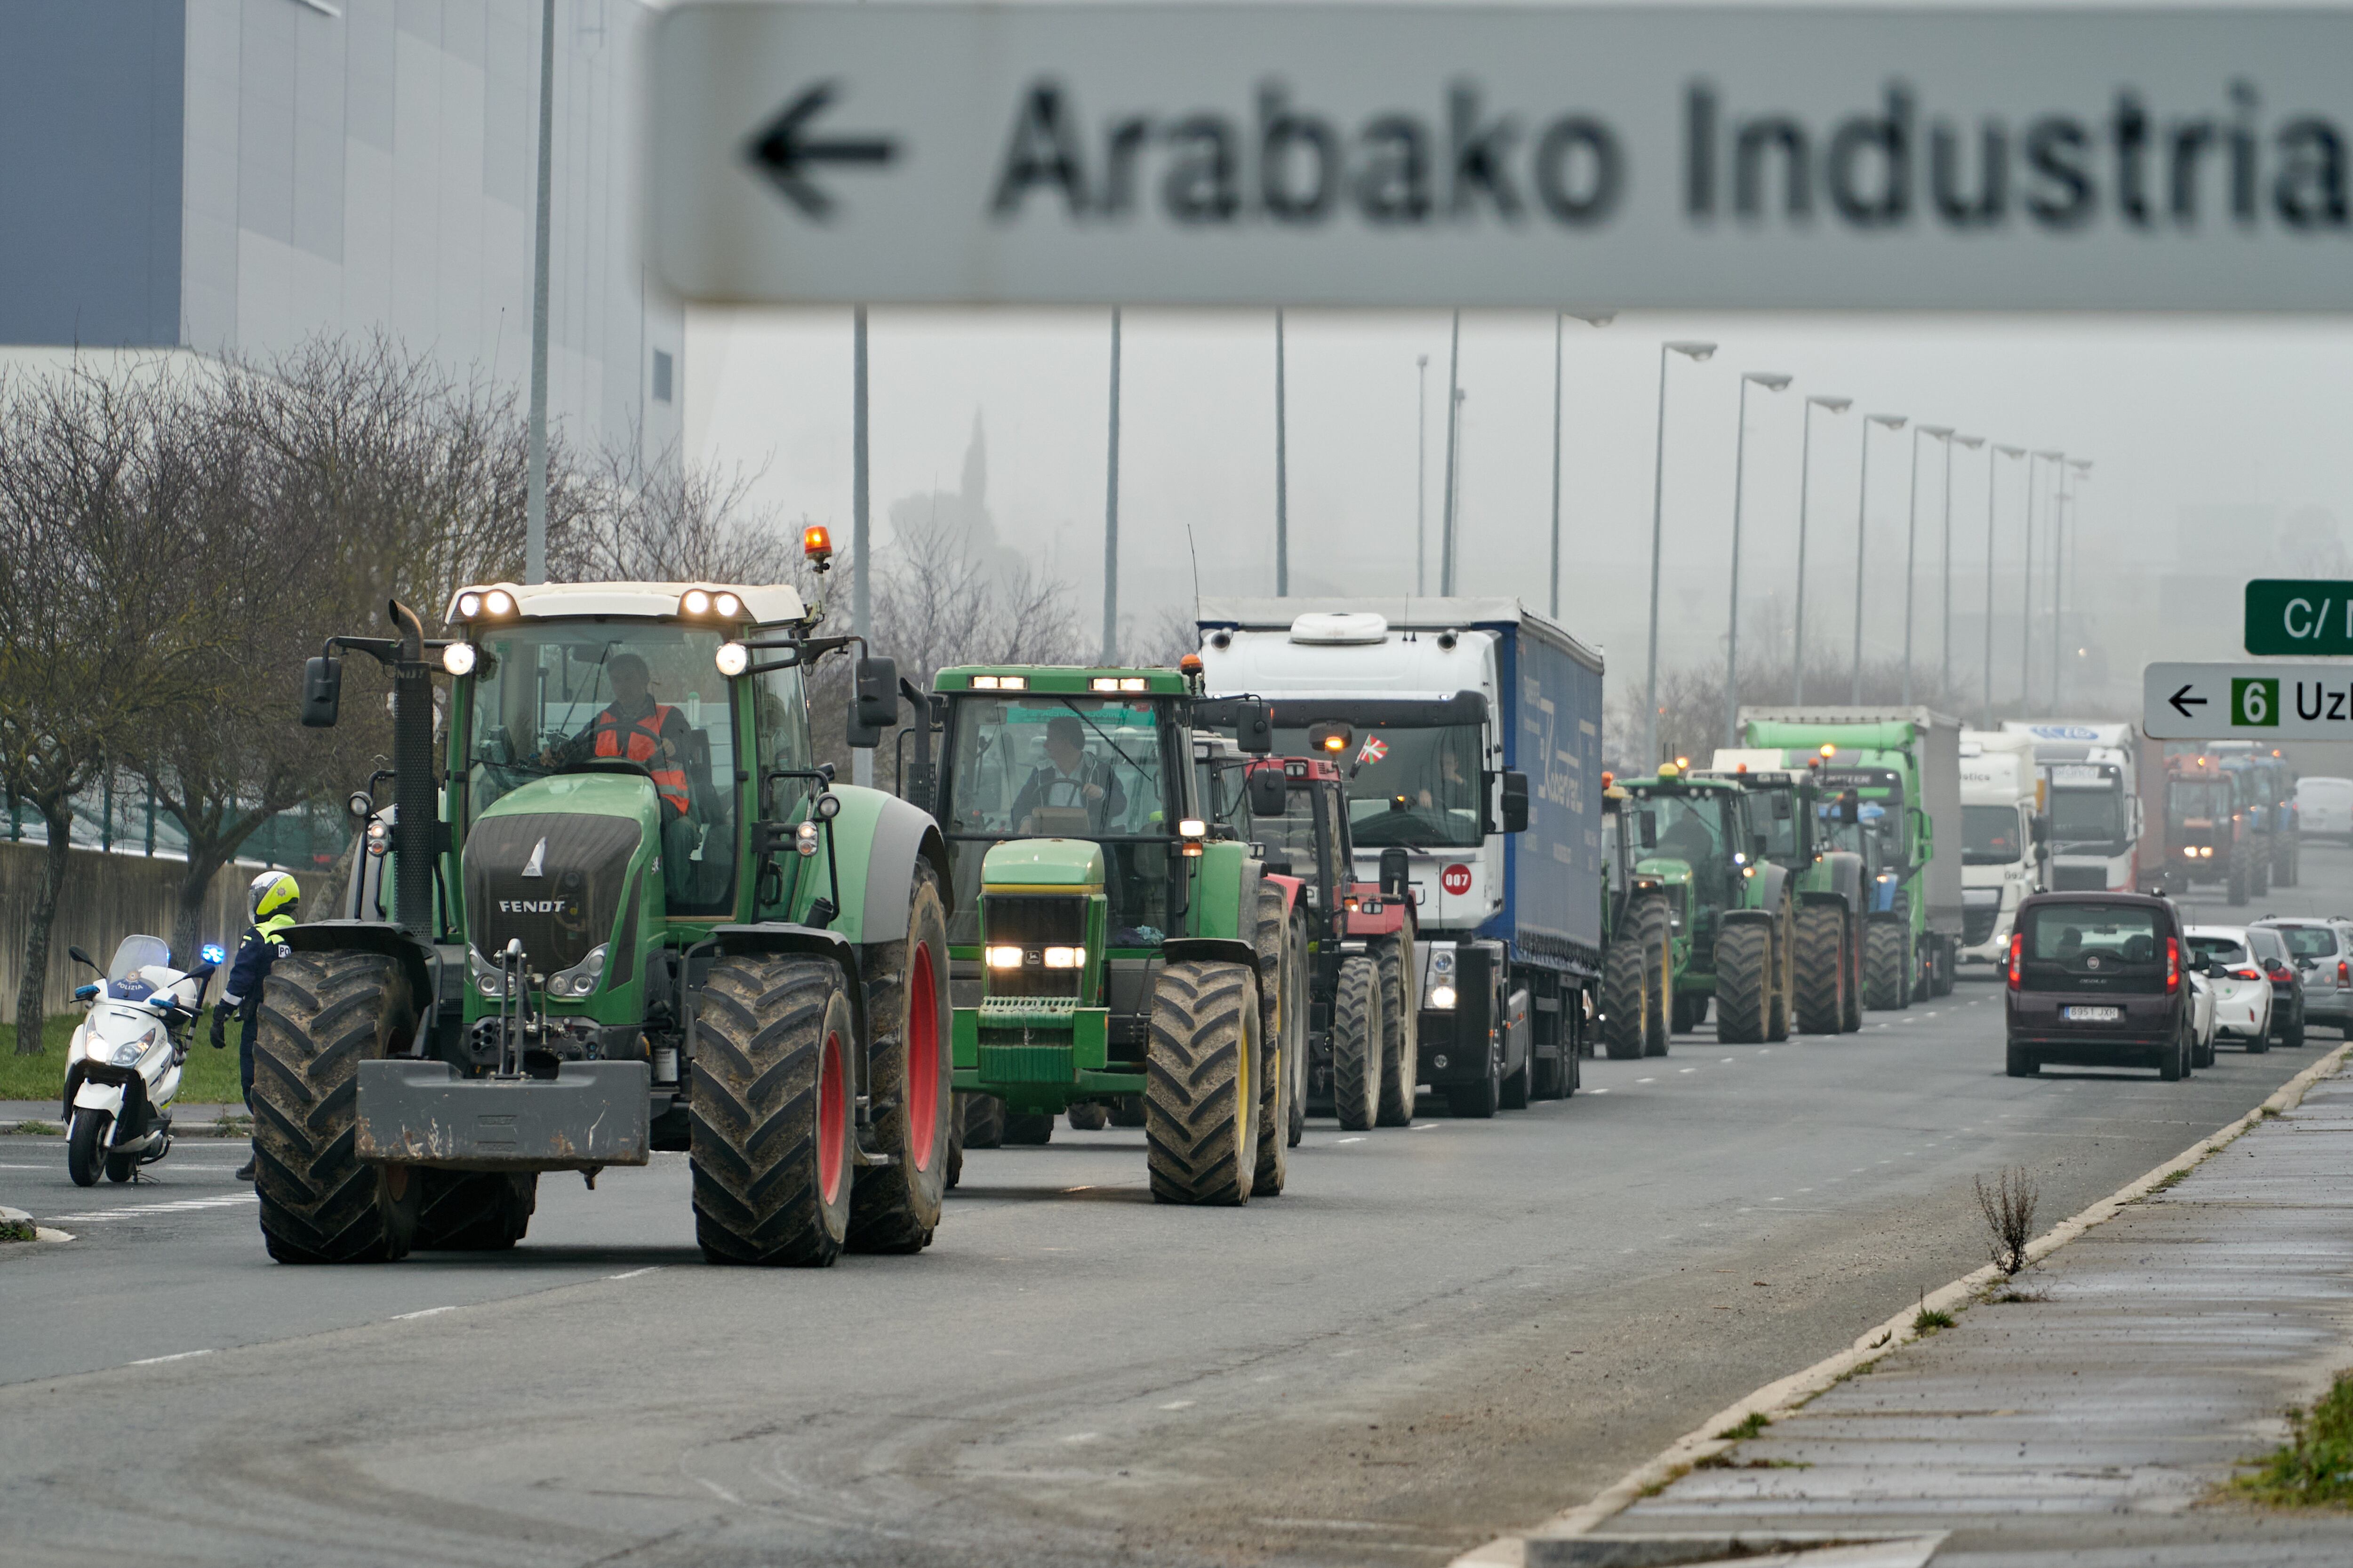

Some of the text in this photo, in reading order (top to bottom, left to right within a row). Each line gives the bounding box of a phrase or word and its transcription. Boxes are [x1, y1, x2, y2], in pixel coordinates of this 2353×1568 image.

[986, 73, 1627, 228] Arabako
[2284, 598, 2330, 638] C/
[2243, 682, 2266, 722] 6
[1446, 874, 1468, 886] 007
[498, 901, 565, 912] FENDT
[117, 981, 143, 990] POLIZIA
